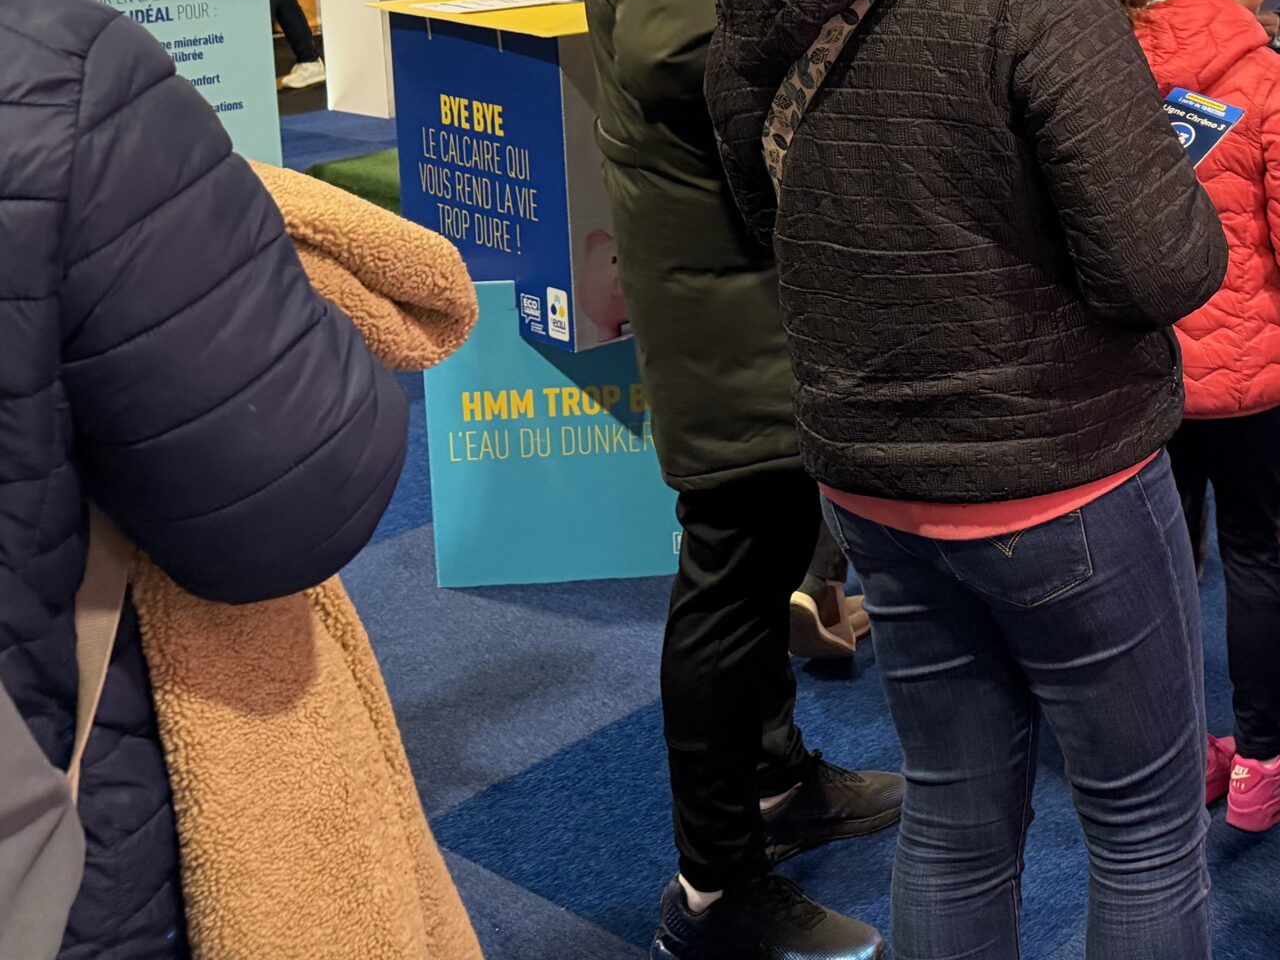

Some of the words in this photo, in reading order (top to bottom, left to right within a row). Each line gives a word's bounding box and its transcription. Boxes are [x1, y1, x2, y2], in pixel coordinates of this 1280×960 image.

[177, 2, 209, 20] POUR
[174, 33, 225, 49] minéralité
[191, 74, 220, 87] onfort
[440, 93, 470, 130] BYE
[472, 100, 504, 137] BYE
[1186, 113, 1217, 128] Chrono
[422, 126, 437, 159] LE
[440, 130, 502, 175] CALCAIRE
[506, 145, 530, 181] QUI
[418, 162, 451, 200] VOUS
[455, 171, 491, 210] REND
[496, 181, 514, 216] LA
[515, 185, 539, 222] VIE
[437, 203, 470, 240] TROP
[474, 213, 512, 253] DURE
[523, 297, 538, 310] ECO
[462, 389, 534, 422] HMM
[543, 384, 621, 418] TROP
[449, 430, 510, 462] L'EAU
[520, 427, 551, 458] DU
[561, 422, 656, 456] DUNKER
